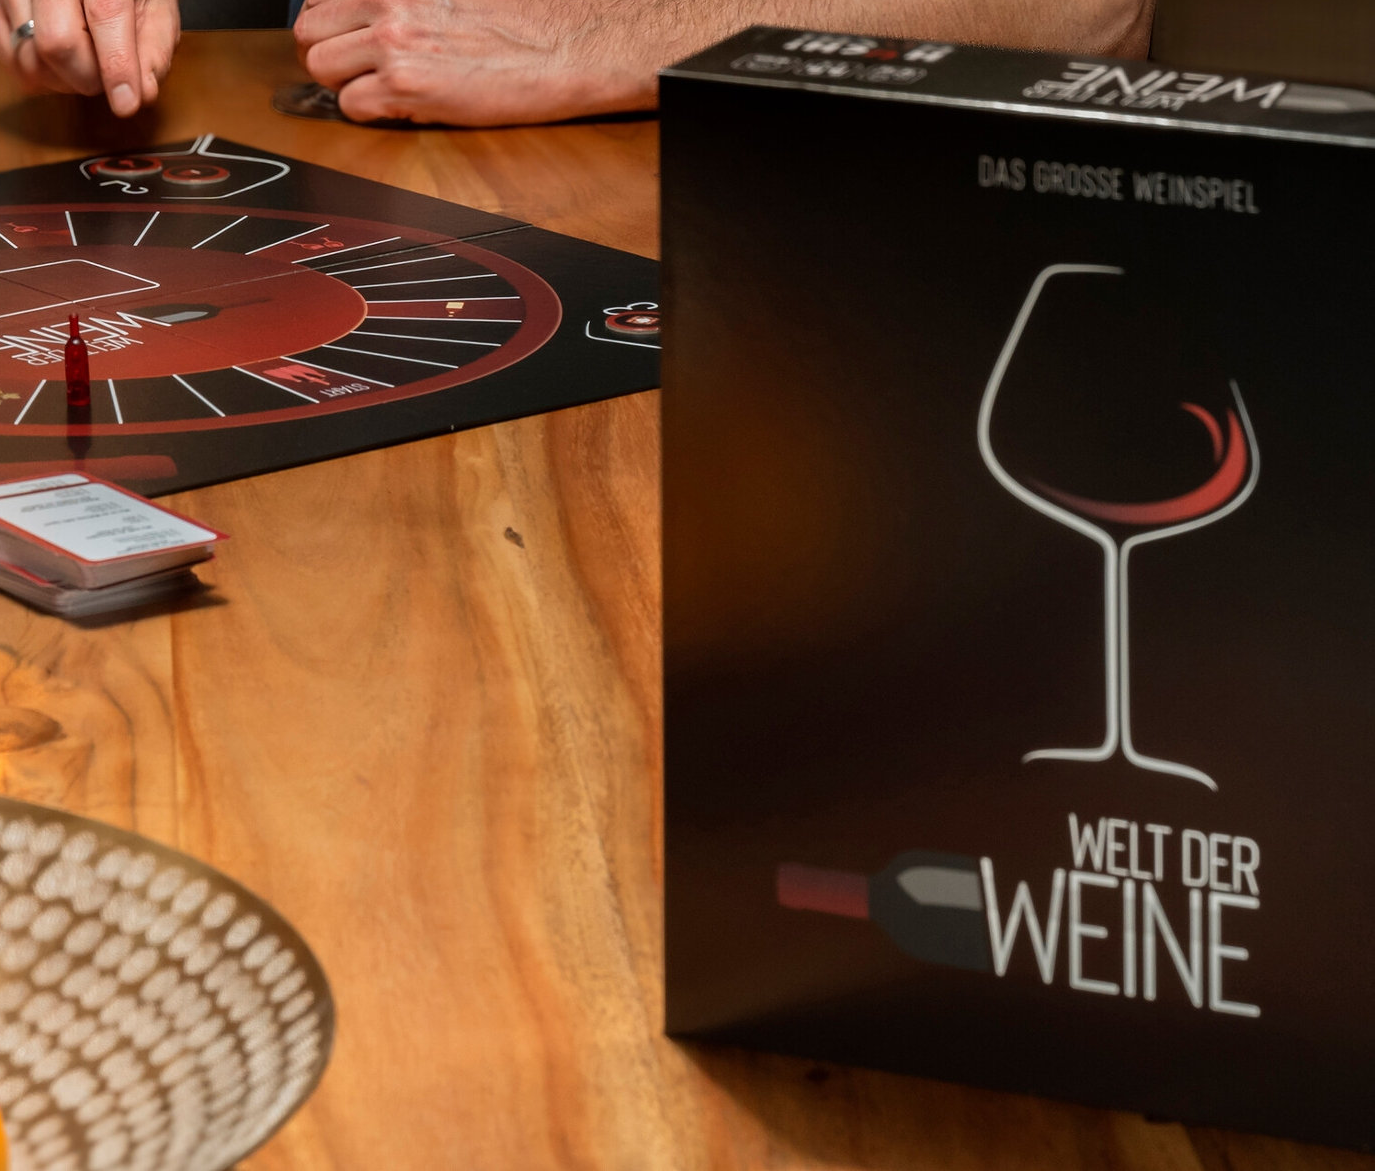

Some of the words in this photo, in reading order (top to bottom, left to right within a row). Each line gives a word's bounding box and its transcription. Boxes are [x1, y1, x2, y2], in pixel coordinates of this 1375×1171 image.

[1035, 62, 1285, 109] WEINE
[978, 155, 1026, 190] DAS
[1033, 160, 1124, 201] GROSSE
[1132, 171, 1260, 214] WEINSPIEL
[318, 383, 371, 398] START
[1068, 812, 1173, 882] WELT
[1181, 828, 1261, 895] DER
[979, 856, 1261, 1018] WEINE
